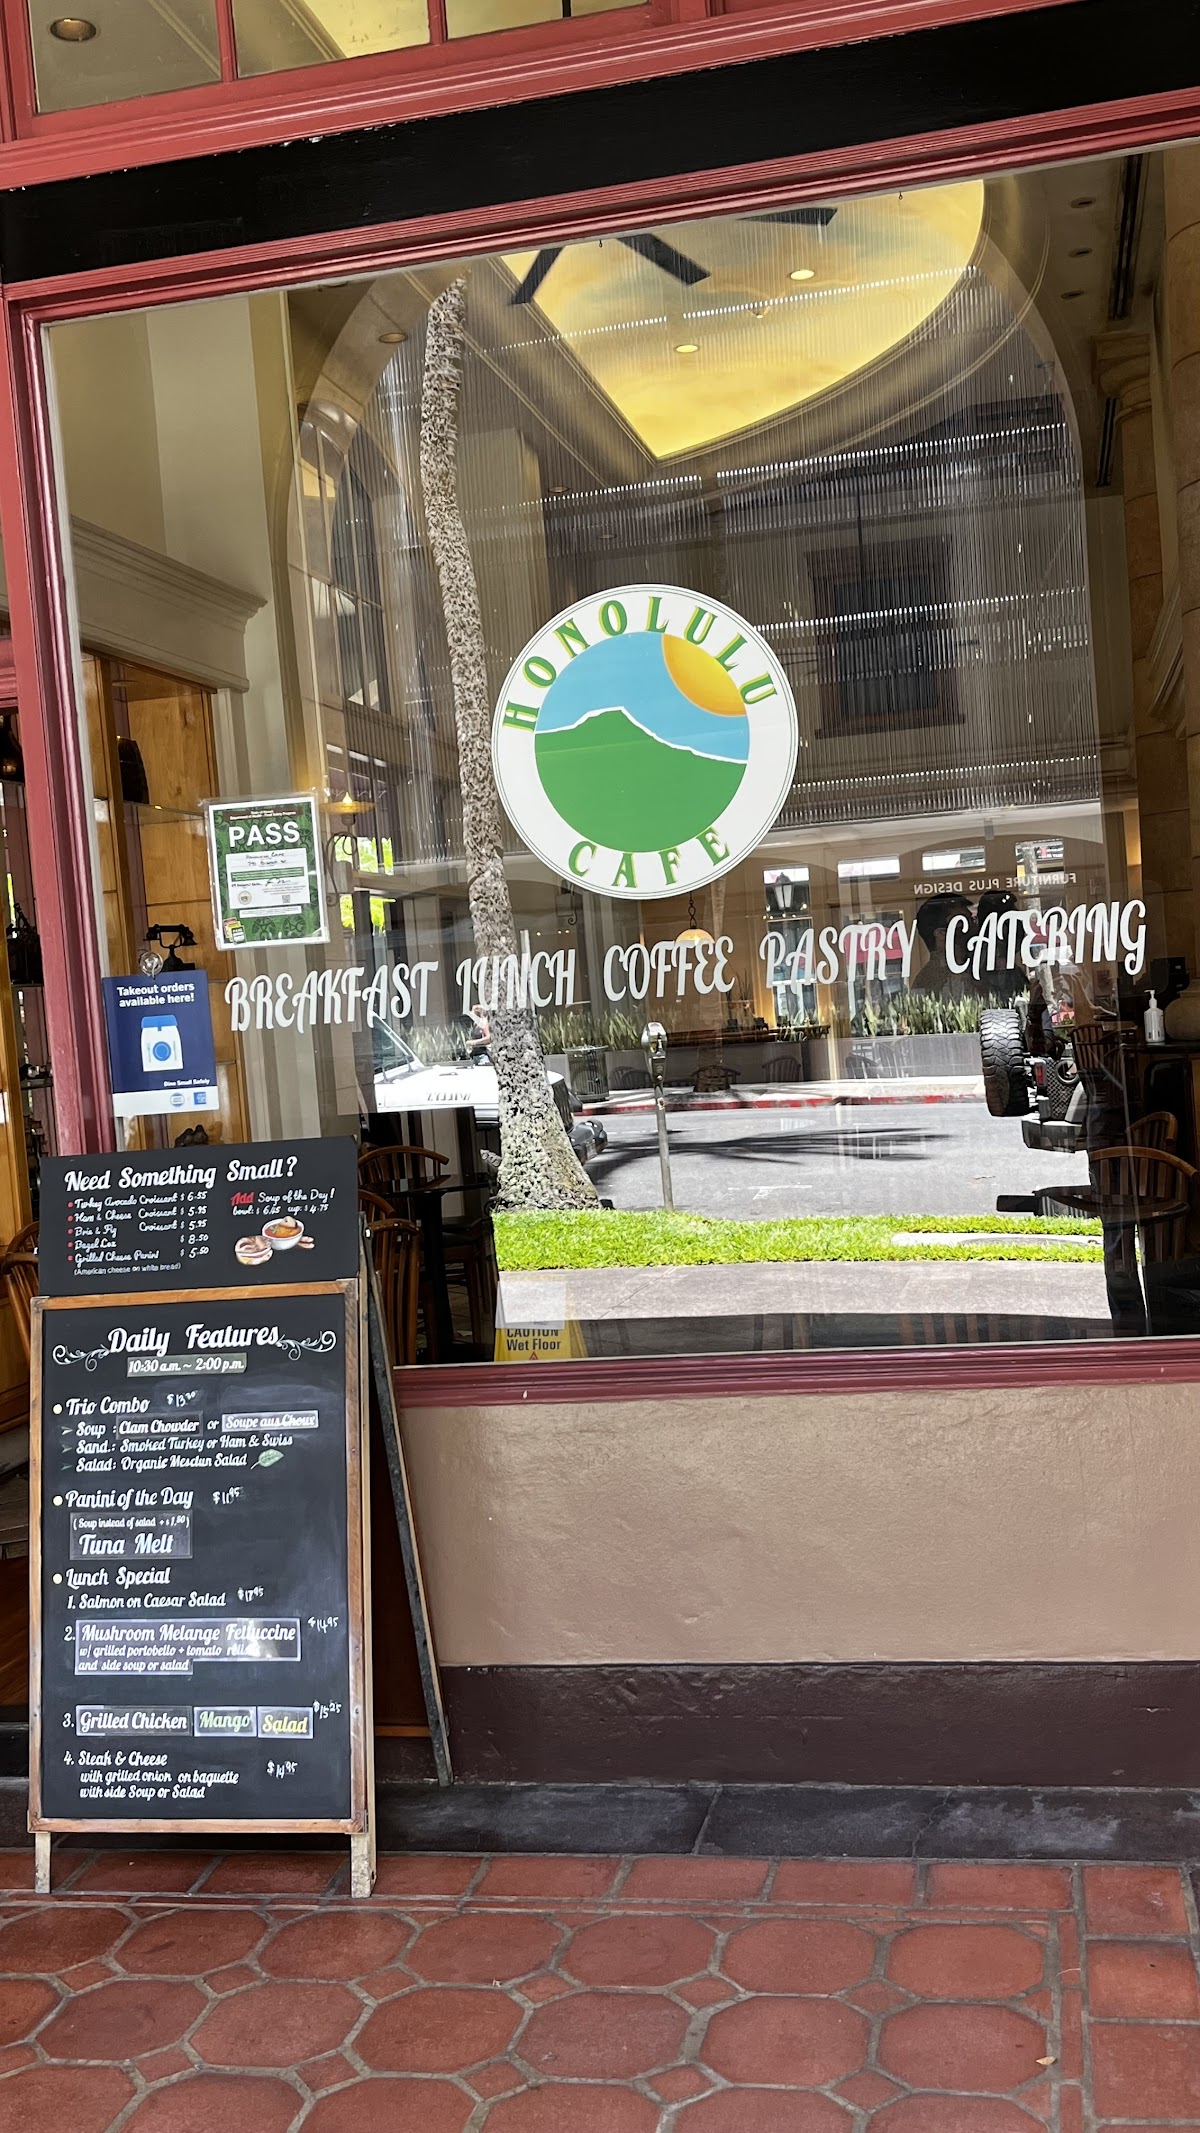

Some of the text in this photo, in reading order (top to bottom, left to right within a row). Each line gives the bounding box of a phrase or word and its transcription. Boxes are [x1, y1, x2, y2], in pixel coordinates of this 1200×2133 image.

[502, 596, 778, 732] HONOLULU
[228, 821, 300, 848] PASS
[568, 826, 731, 889] CAFE
[224, 900, 1147, 1034] BREAKFAST LUNCH COFFEE PASTRY CATERING
[117, 982, 195, 997] Takeout orders
[119, 992, 195, 1008] available here!
[192, 1078, 211, 1086] Safely
[64, 1156, 298, 1192] Need Something Small?
[74, 1197, 102, 1212] Turkey
[104, 1194, 137, 1206] Avocado
[139, 1192, 178, 1205] Croissant
[230, 1192, 255, 1206] Add
[258, 1192, 280, 1206] Soup
[282, 1190, 294, 1203] of
[293, 1188, 308, 1200] the
[74, 1213, 94, 1222] Ham
[104, 1209, 132, 1220] Cheese
[138, 1206, 178, 1219] Croissant
[74, 1226, 93, 1237] Brie
[102, 1224, 118, 1238] Fig
[138, 1220, 178, 1232] Croissant
[74, 1237, 100, 1253] Bagel
[100, 1238, 117, 1248] Lox
[74, 1250, 104, 1268] Grilled
[105, 1250, 132, 1262] Cheese
[134, 1250, 160, 1261] Panini
[108, 1323, 280, 1358] Daily Features
[507, 1338, 562, 1351] Wet Floor
[128, 1360, 159, 1374] 10:30
[160, 1362, 181, 1372] a.m.
[194, 1357, 222, 1370] 2:00
[222, 1360, 245, 1373] p.m.
[66, 1398, 98, 1415] Trio
[100, 1396, 150, 1414] Combo
[76, 1422, 106, 1439] Soup
[119, 1420, 148, 1435] Clam
[151, 1419, 200, 1434] Chowder
[206, 1420, 220, 1430] or
[226, 1415, 258, 1430] Soupe
[120, 1438, 167, 1452] Smoked
[167, 1436, 205, 1452] Turkey
[206, 1439, 219, 1448] or
[220, 1434, 246, 1448] Ham
[248, 1434, 260, 1448] &
[262, 1433, 294, 1447] Swiss
[76, 1458, 117, 1472] Salad:
[121, 1455, 168, 1474] Organic
[214, 1452, 248, 1467] Salad
[66, 1490, 116, 1508] Panini
[116, 1488, 135, 1510] of
[135, 1488, 158, 1506] the
[160, 1486, 194, 1509] Day
[98, 1518, 126, 1528] instead
[126, 1516, 136, 1530] of
[135, 1517, 156, 1528] salad
[79, 1532, 174, 1555] Tuna Melt
[66, 1566, 171, 1590] Lunch Special
[67, 1594, 76, 1610] 1.
[78, 1593, 125, 1609] Salmon
[126, 1596, 142, 1608] on
[144, 1592, 186, 1608] Caesar
[188, 1591, 227, 1608] Salad
[64, 1624, 76, 1642] 2.
[81, 1624, 155, 1642] Mushroom
[159, 1624, 220, 1646] Melange
[80, 1644, 92, 1658] w/
[92, 1645, 126, 1658] grilled
[126, 1645, 176, 1658] portobello
[186, 1644, 222, 1656] tomato
[78, 1659, 190, 1673] and side soup or salad
[62, 1712, 75, 1728] 3.
[80, 1712, 130, 1732] Grilled
[132, 1712, 188, 1730] Chicken
[200, 1711, 251, 1732] Mango
[262, 1714, 308, 1734] Salad
[64, 1750, 168, 1766] 4. Steak & Cheese
[80, 1769, 240, 1788] with grilled onion on baguette
[80, 1784, 206, 1802] with side Soup or Salad
